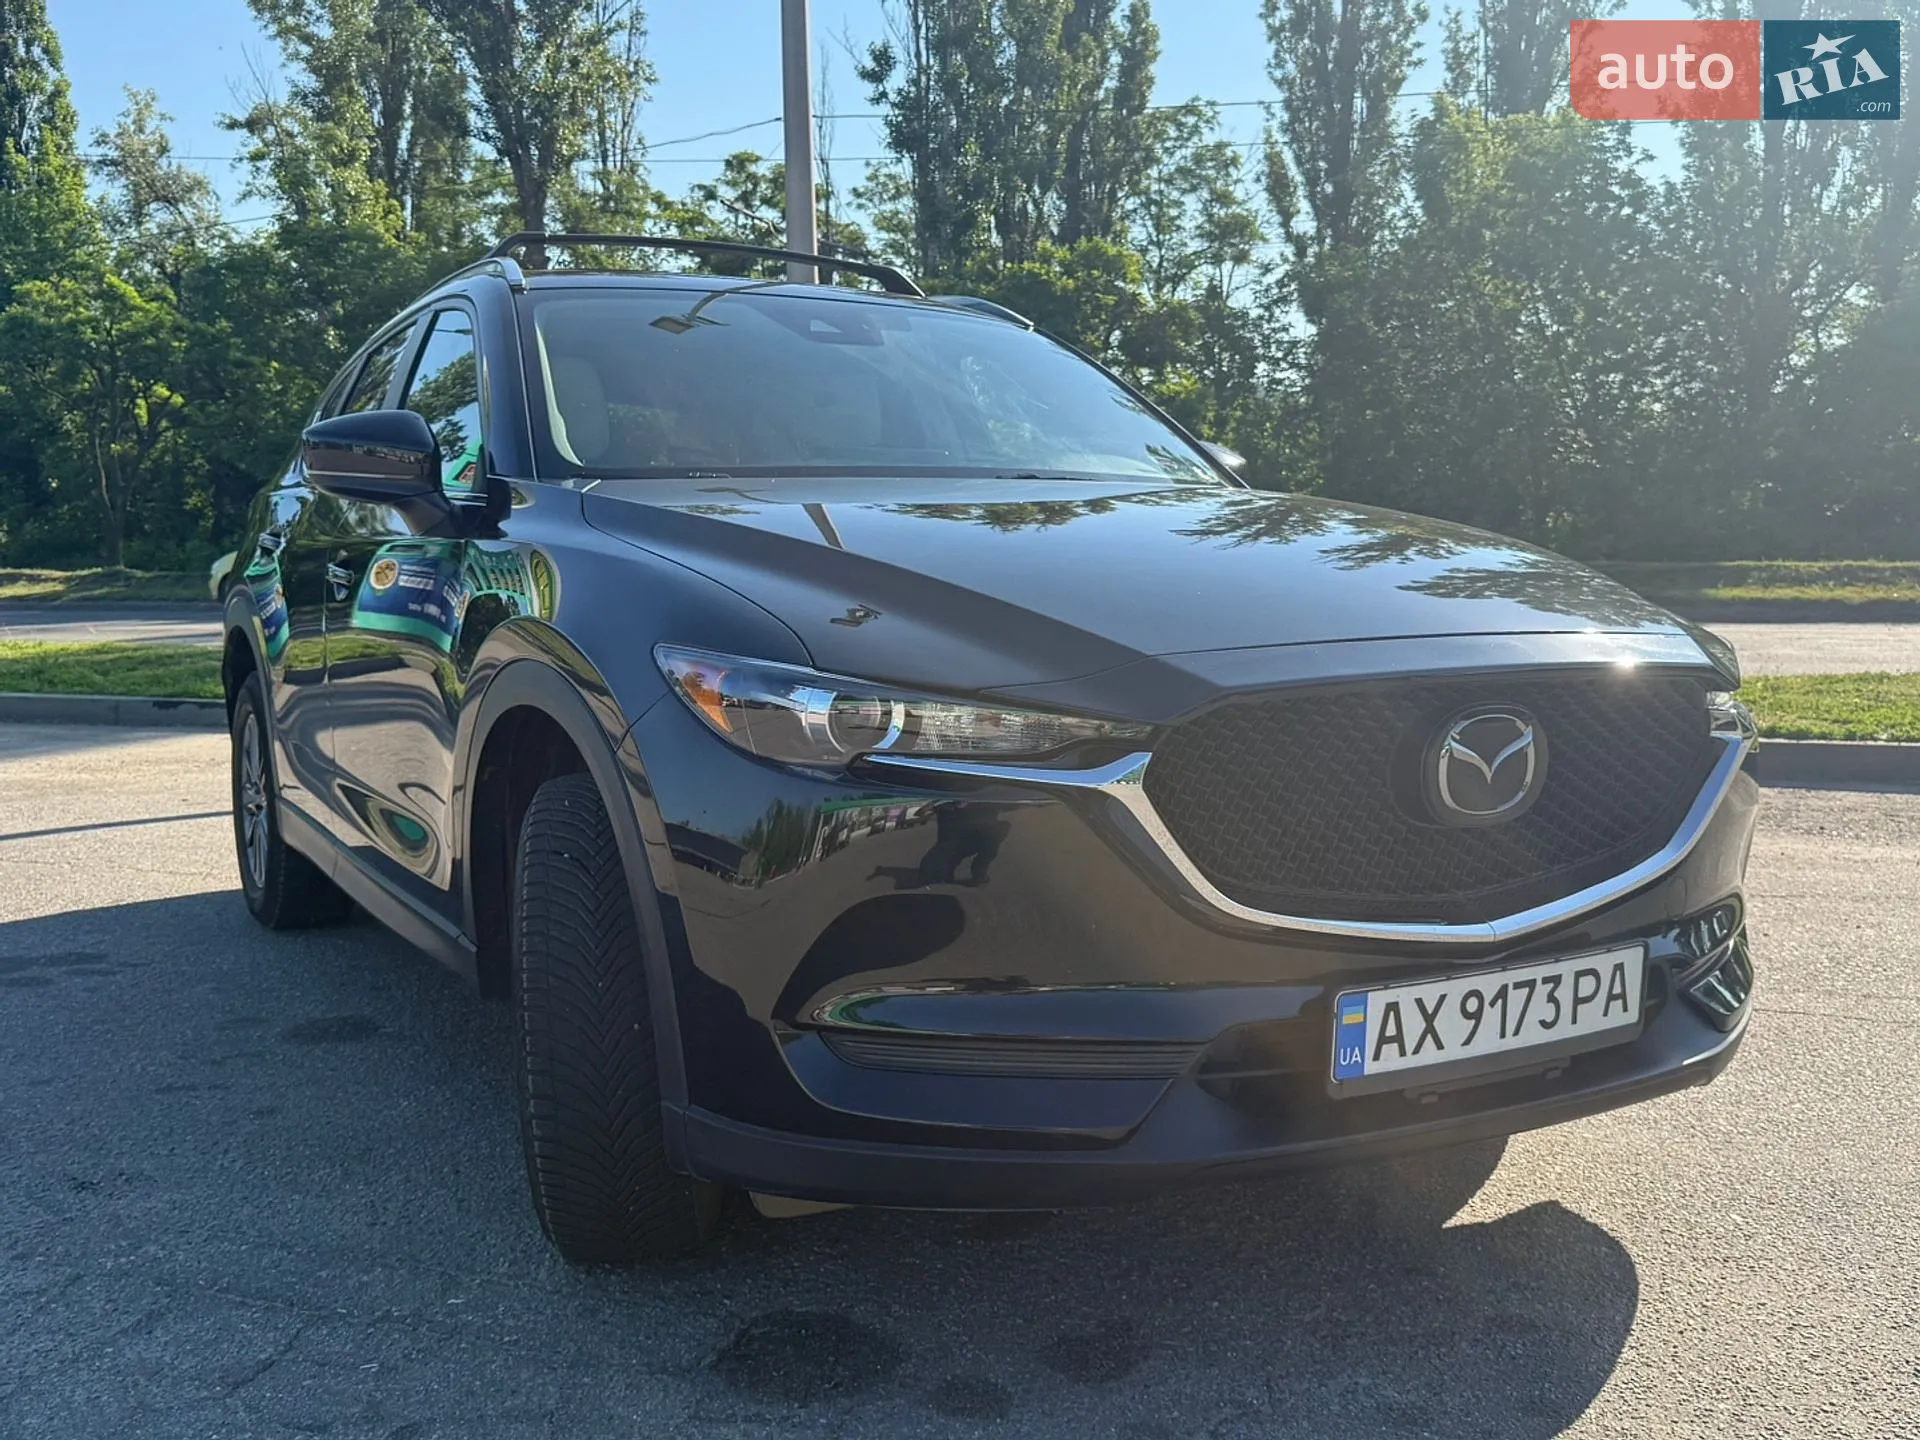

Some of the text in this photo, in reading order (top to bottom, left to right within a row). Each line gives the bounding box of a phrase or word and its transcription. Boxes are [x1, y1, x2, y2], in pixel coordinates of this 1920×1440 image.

[1372, 961, 1629, 1062] AX 9173 PA
[1339, 1046, 1363, 1066] UA
